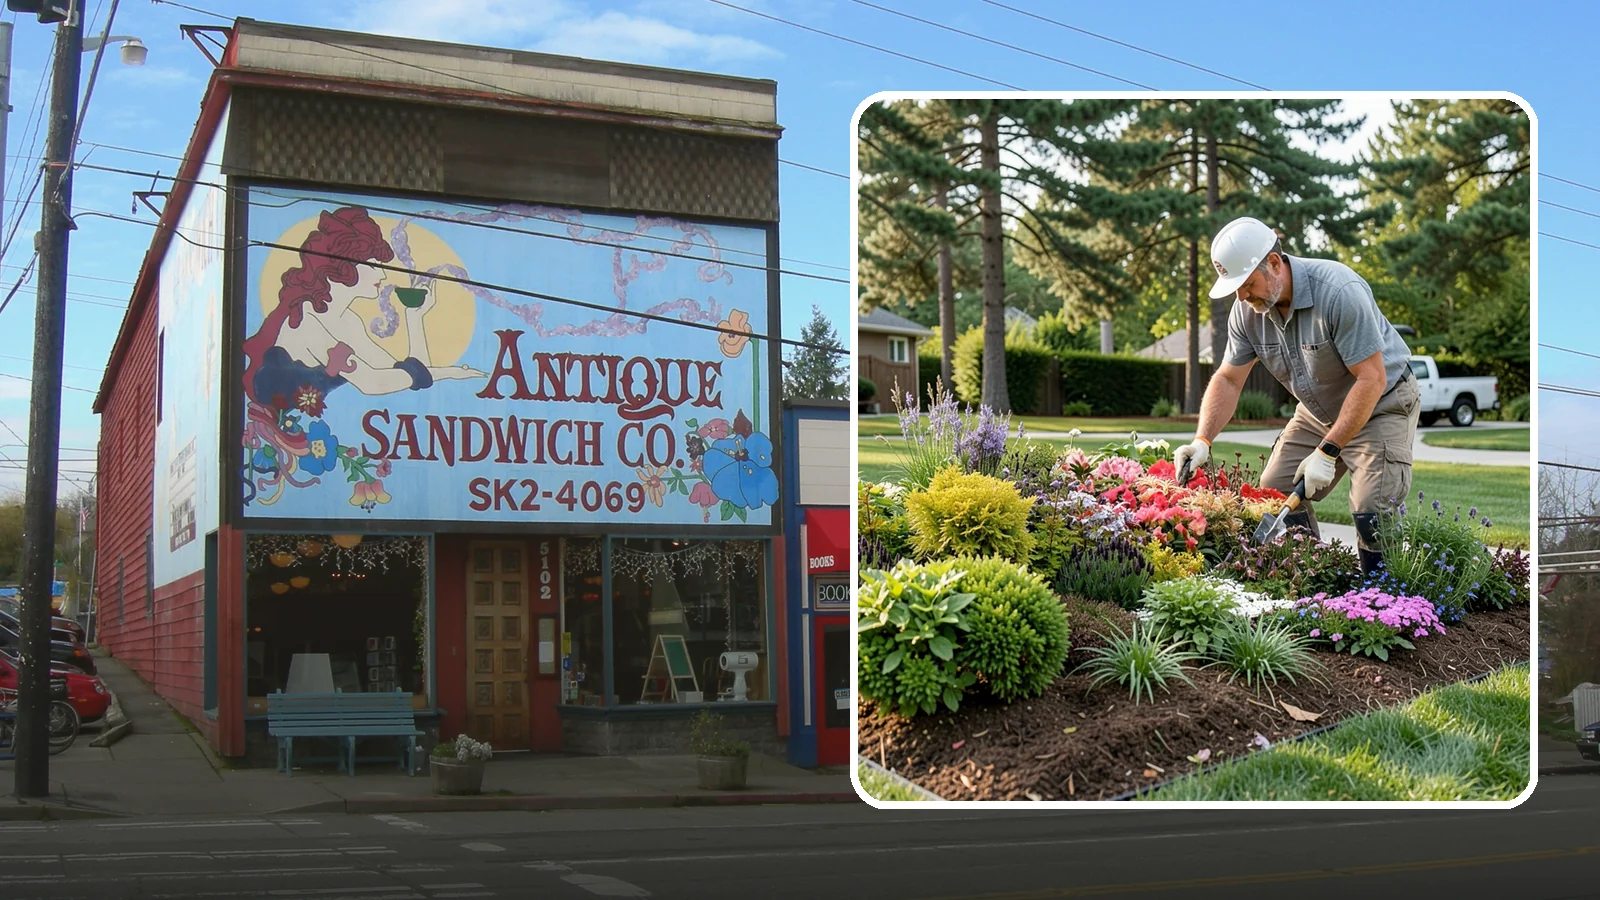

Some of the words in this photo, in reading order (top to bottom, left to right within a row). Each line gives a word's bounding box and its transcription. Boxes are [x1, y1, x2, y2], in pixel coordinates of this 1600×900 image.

[476, 329, 723, 421] ANTIQUE
[361, 408, 605, 467] SANDWICH
[616, 422, 685, 468] CO.
[468, 477, 646, 513] SK2-4069
[539, 541, 551, 600] 5102
[809, 555, 835, 568] BOOKS
